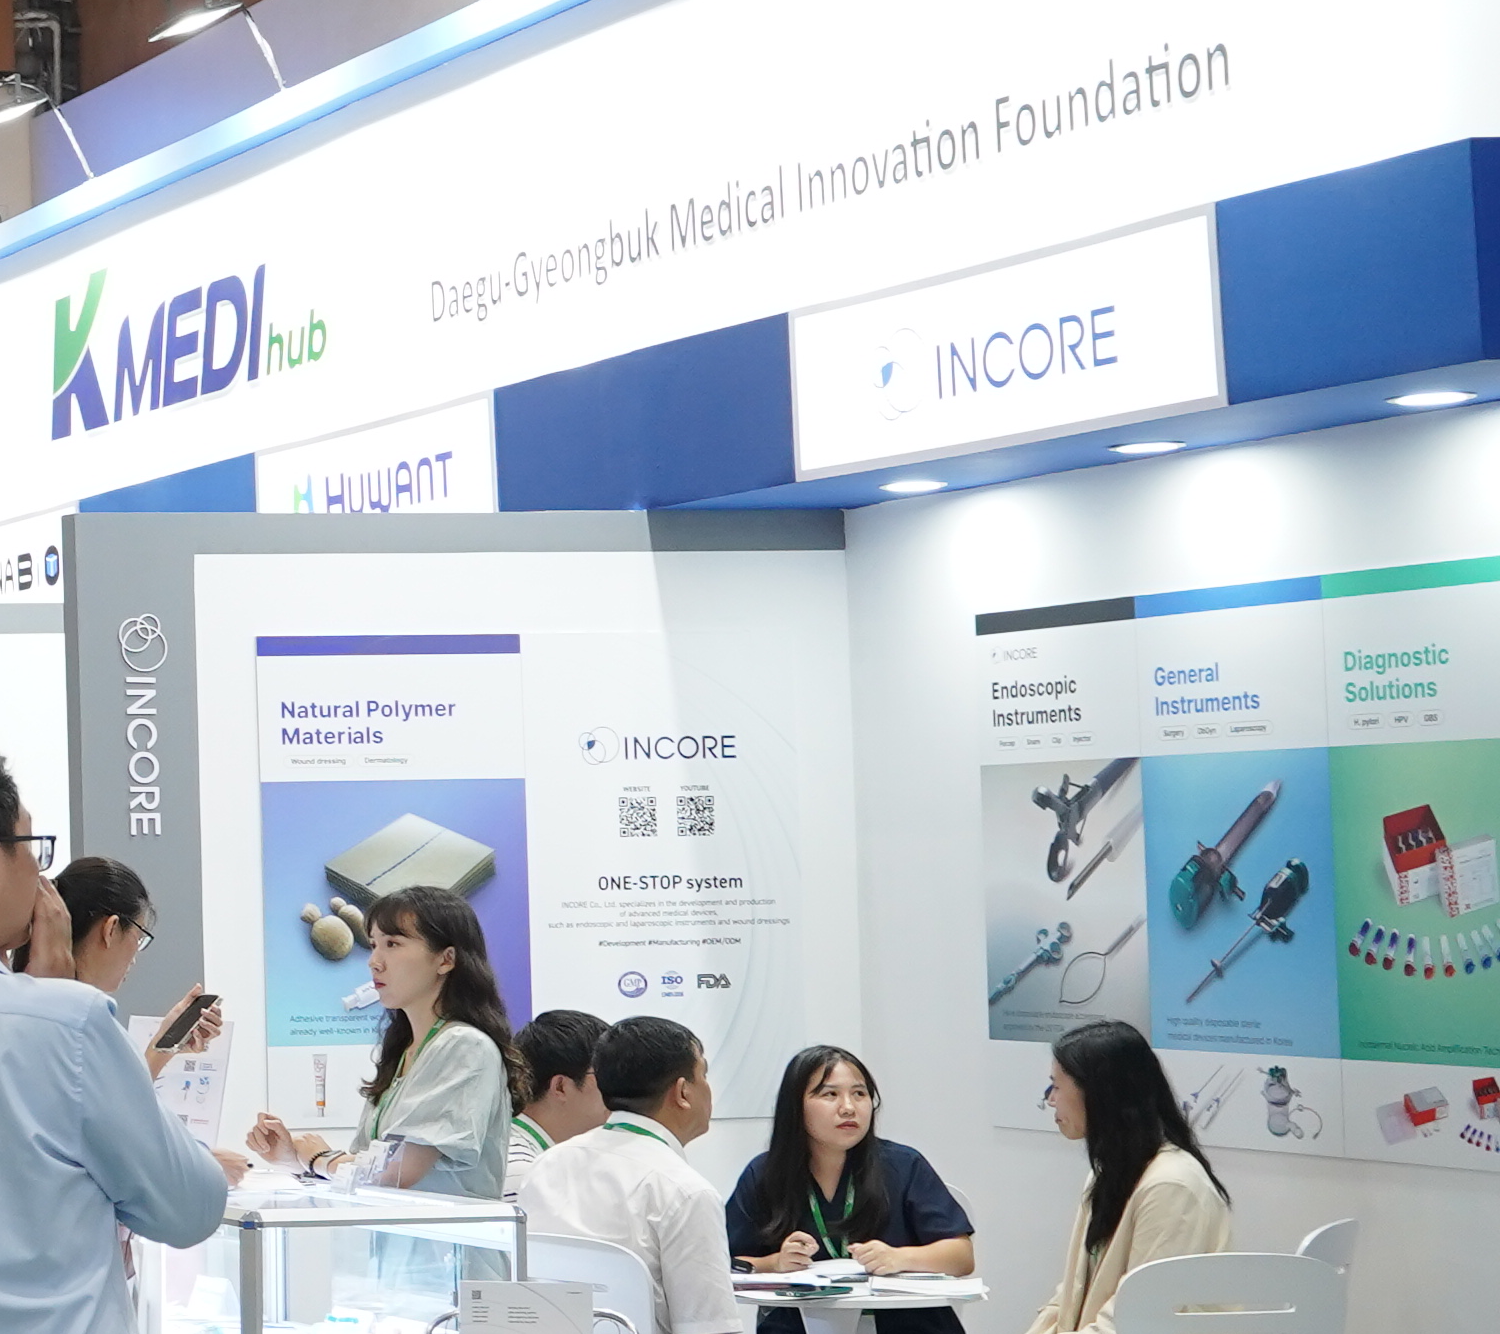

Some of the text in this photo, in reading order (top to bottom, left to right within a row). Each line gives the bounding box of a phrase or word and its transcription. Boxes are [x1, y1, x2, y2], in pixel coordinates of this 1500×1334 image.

[431, 41, 1231, 324] Daegu-Gyeongbuk Medical Innovation Foundation
[936, 304, 1119, 400] INCORE
[324, 450, 454, 513] HUWANT
[1343, 643, 1450, 676] Diagnostic
[991, 675, 1077, 700] Endoscopic
[1154, 662, 1220, 687] General
[1344, 676, 1438, 705] Solutions
[280, 698, 456, 723] Natural Polymer
[992, 704, 1082, 728] Instruments
[1155, 691, 1260, 717] Instruments
[280, 725, 384, 747] Materials
[623, 733, 737, 761] INCORE
[125, 675, 162, 837] INCORE
[598, 875, 743, 893] ONE-STOP system
[660, 973, 732, 989] ISO FDA
